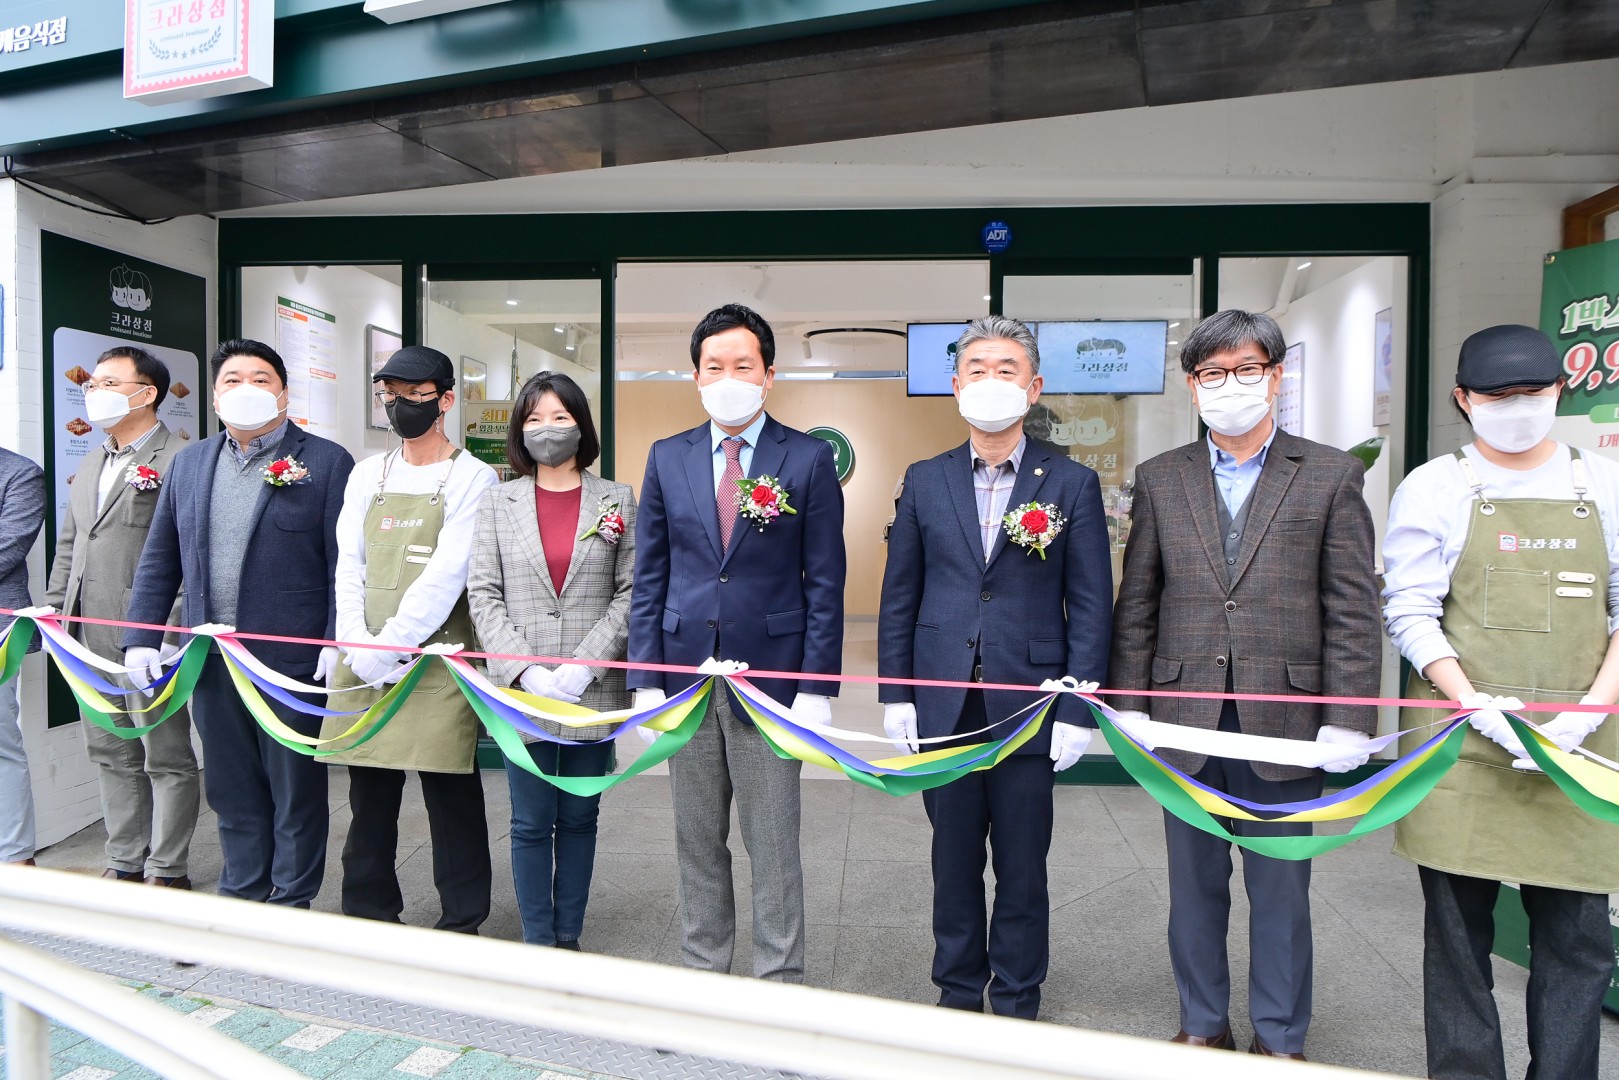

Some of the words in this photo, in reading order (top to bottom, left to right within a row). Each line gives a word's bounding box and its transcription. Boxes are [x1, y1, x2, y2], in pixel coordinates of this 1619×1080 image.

[986, 229, 1008, 241] ADT
[110, 311, 152, 332] 크라상점
[110, 326, 132, 335] croissant
[132, 330, 153, 339] boutique
[1073, 362, 1129, 373] 크라상점
[1518, 538, 1577, 550] 크라상점
